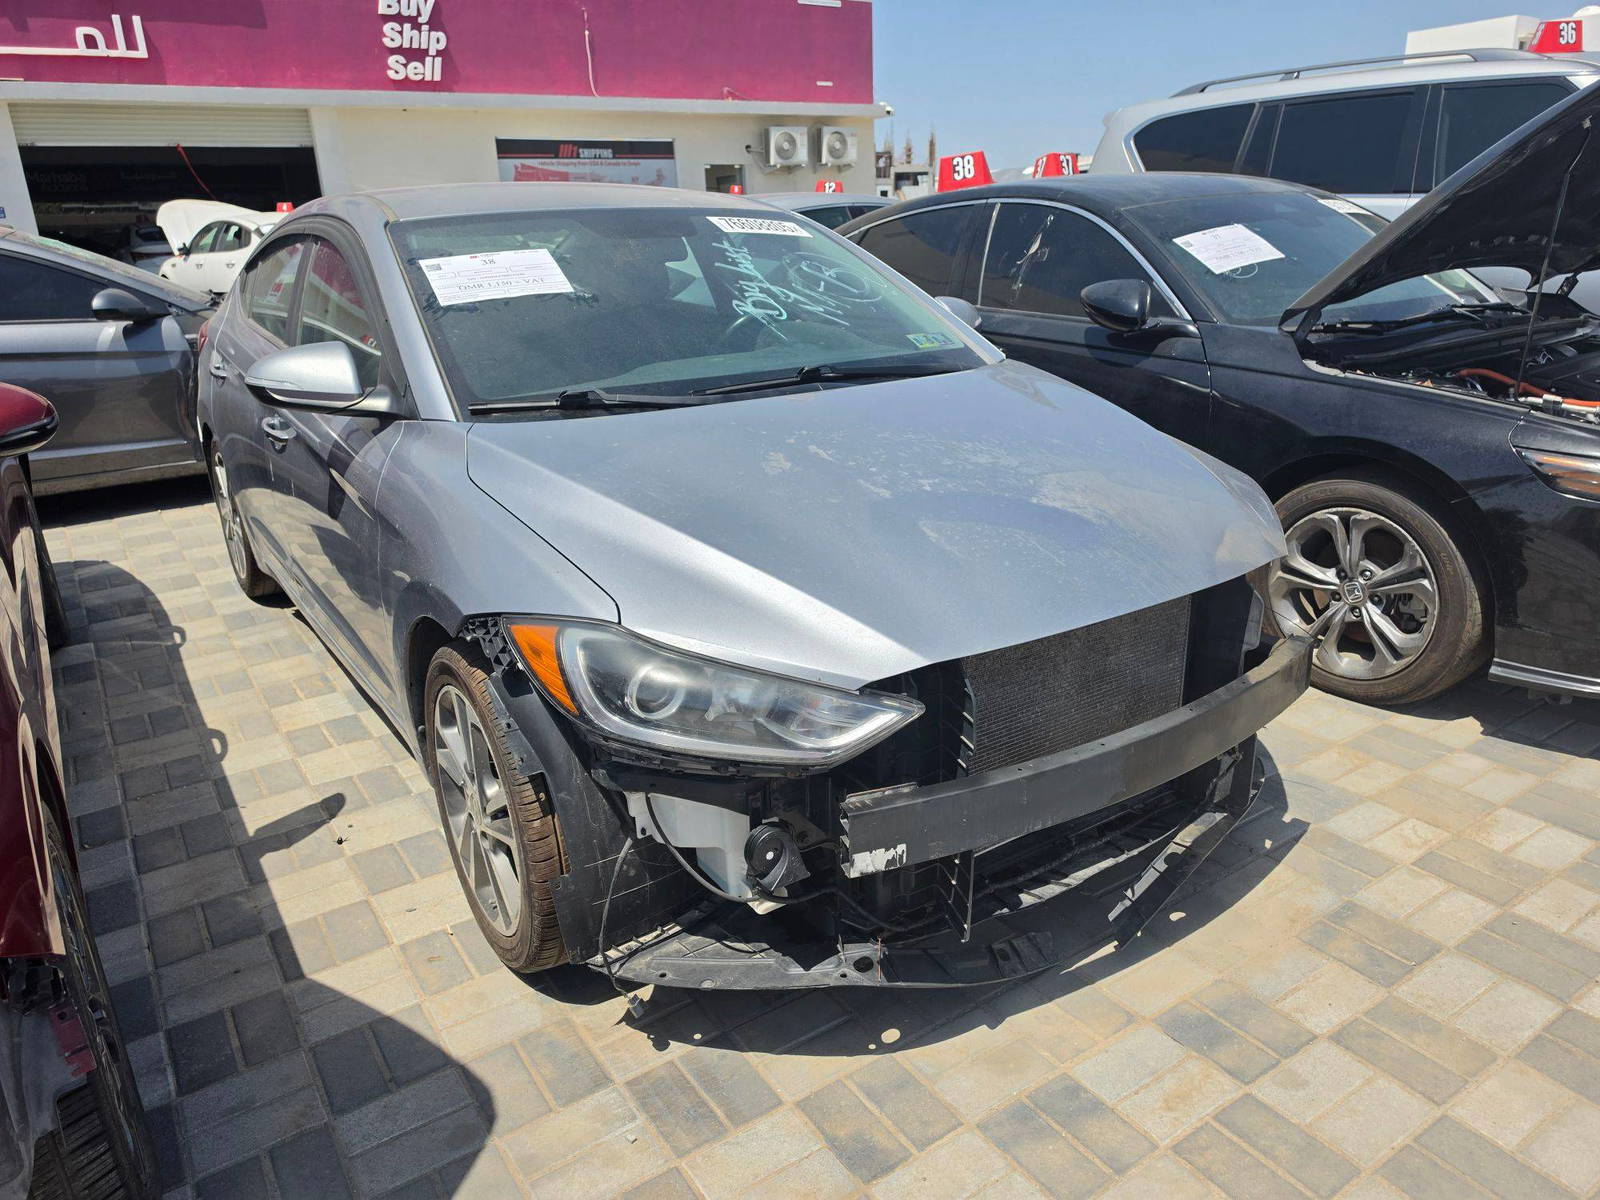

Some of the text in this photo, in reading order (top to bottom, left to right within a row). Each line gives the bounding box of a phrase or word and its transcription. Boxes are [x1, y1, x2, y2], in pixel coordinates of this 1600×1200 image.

[377, 0, 435, 24] Buy
[382, 21, 447, 56] Ship
[1559, 22, 1576, 45] 36
[386, 54, 442, 82] Sell
[579, 148, 613, 158] SHIPPING
[952, 154, 975, 181] 38
[1059, 154, 1074, 176] 37
[824, 181, 836, 194] 12
[481, 258, 496, 266] 38
[457, 283, 484, 291] OMR
[525, 277, 545, 285] VAT
